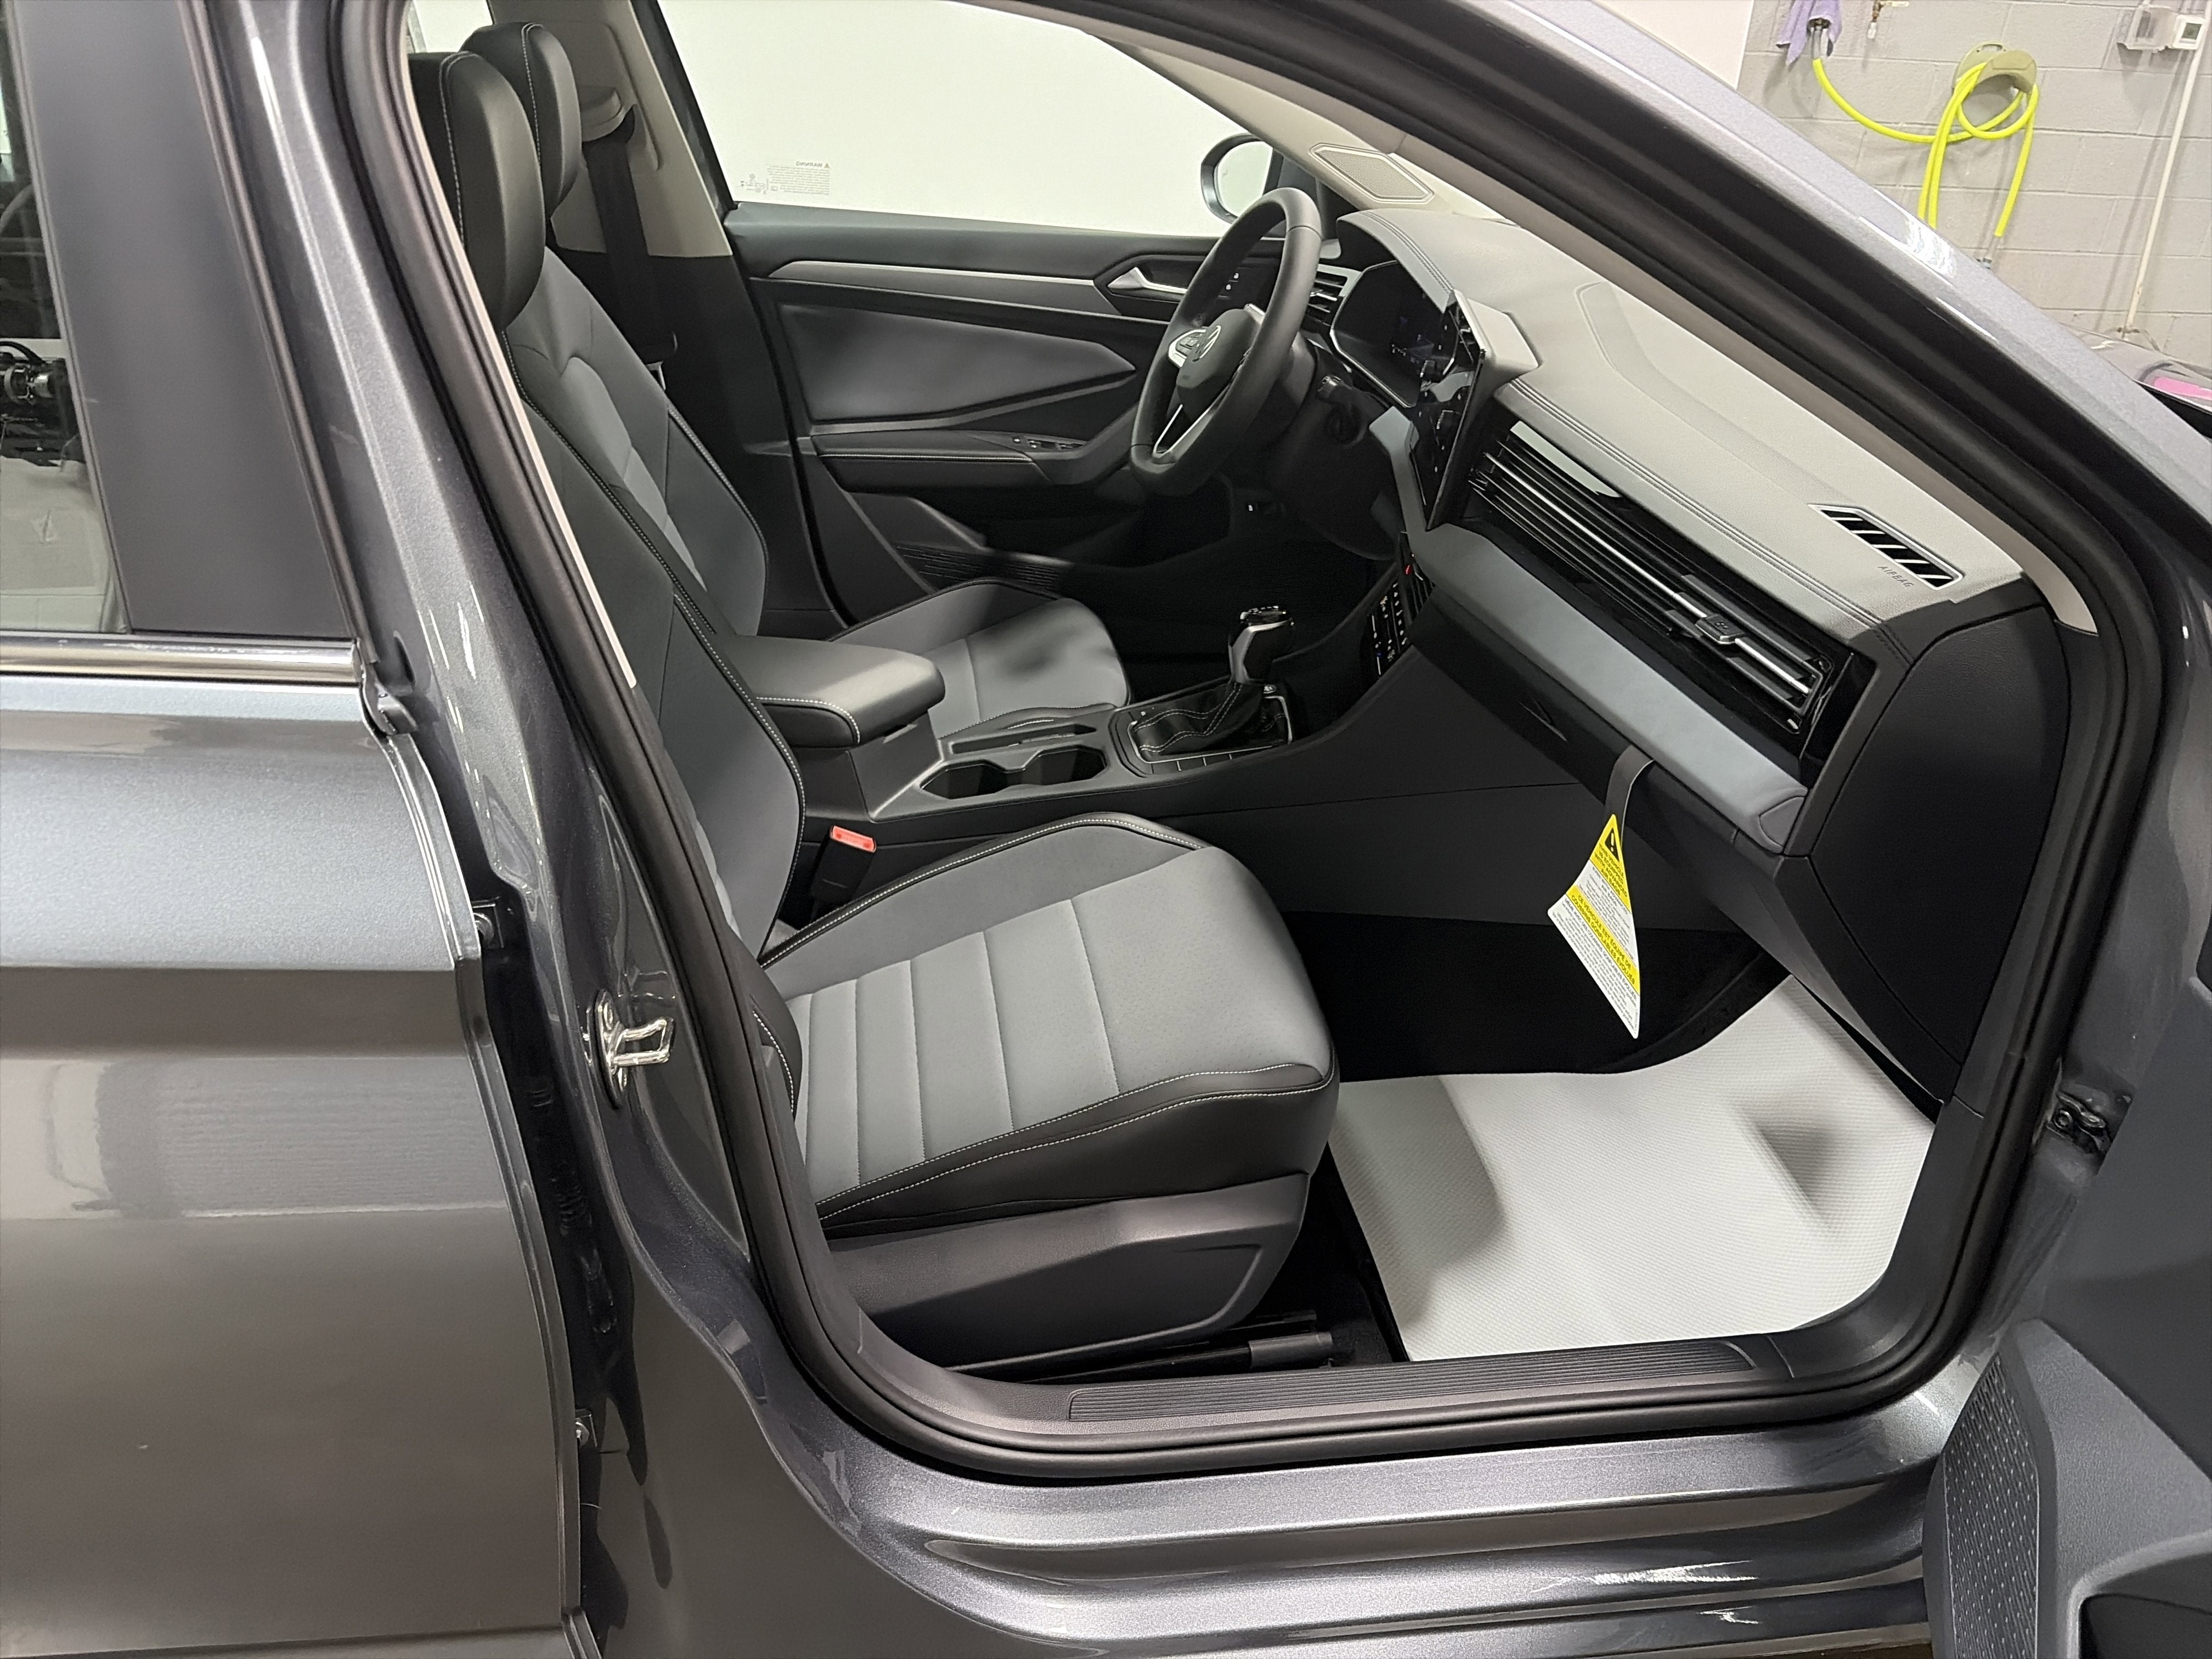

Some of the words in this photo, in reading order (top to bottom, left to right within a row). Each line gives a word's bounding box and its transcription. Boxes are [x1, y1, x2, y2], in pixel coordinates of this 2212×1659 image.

[1877, 566, 1914, 587] AIRBAG
[1600, 868, 1609, 879] AIR
[1609, 877, 1621, 895] BAGS
[1605, 867, 1628, 898] ADVANCED
[1571, 894, 1591, 923] COUSSINS
[1590, 921, 1617, 958] GONFLABLES
[1577, 894, 1585, 905] CE
[1601, 928, 1611, 940] EST
[1624, 959, 1632, 970] DE
